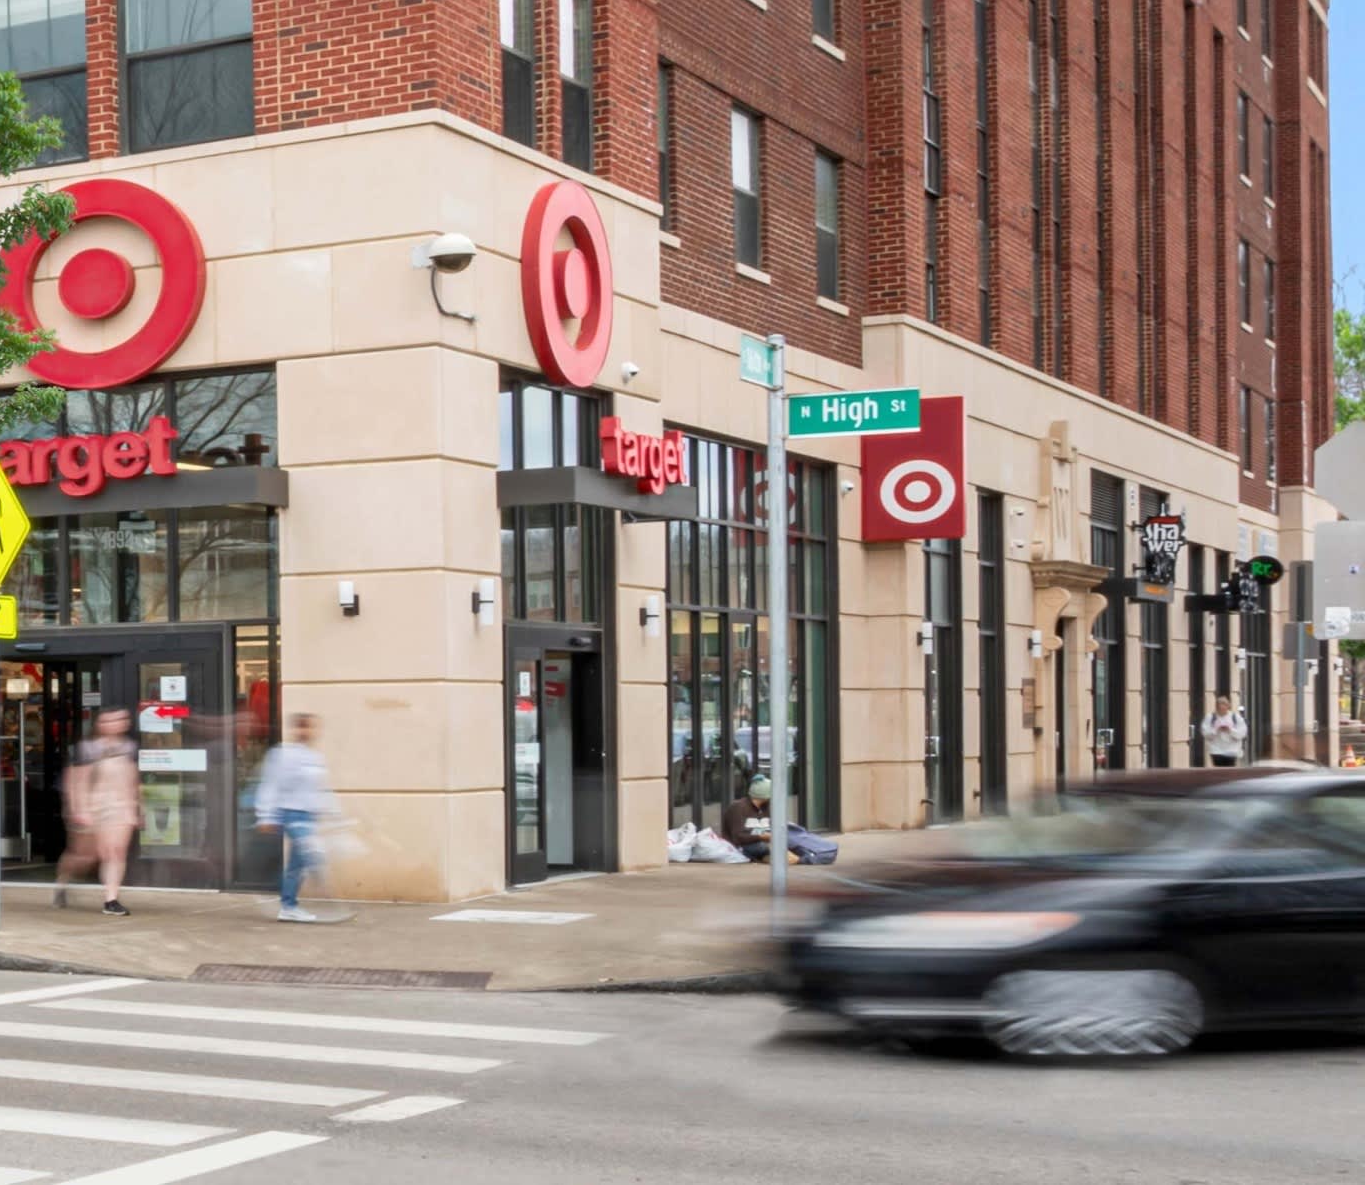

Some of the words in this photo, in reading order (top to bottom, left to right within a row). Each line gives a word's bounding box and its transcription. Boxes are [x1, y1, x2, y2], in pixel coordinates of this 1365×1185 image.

[801, 405, 811, 418] N
[822, 397, 879, 428] High
[890, 399, 906, 413] St
[603, 416, 686, 495] target
